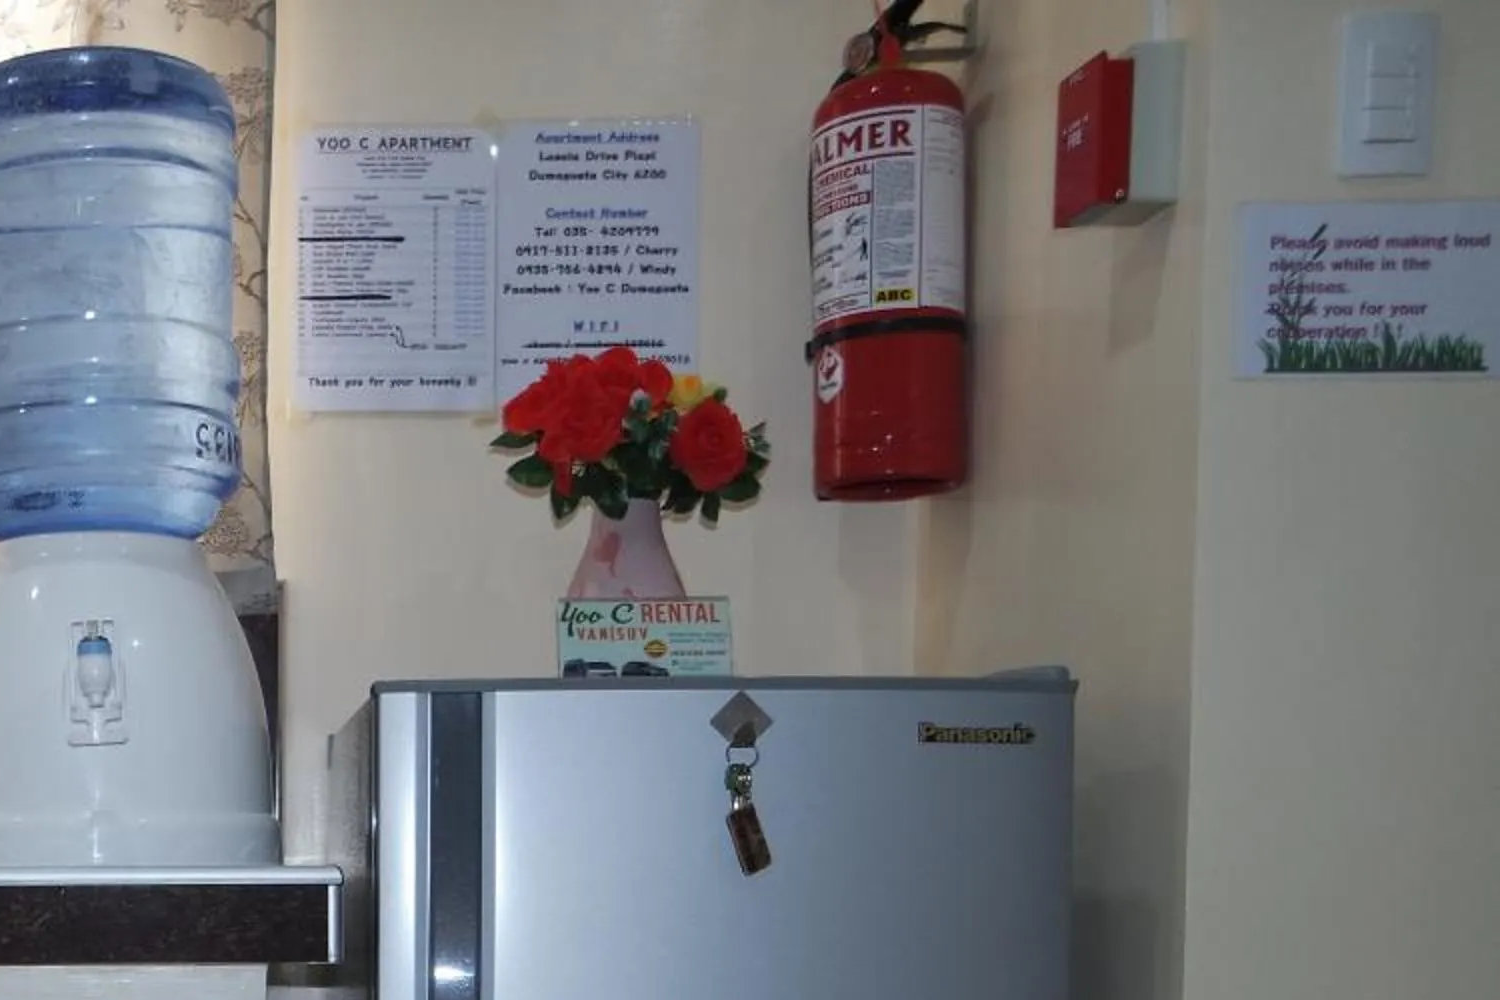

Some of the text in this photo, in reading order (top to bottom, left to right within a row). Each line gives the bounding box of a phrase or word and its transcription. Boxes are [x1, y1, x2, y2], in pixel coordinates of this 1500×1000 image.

[316, 136, 473, 150] YOO C APARTMENT
[602, 169, 629, 182] City
[545, 206, 649, 219] Contact Number
[1269, 233, 1492, 251] Please avoid making loud
[1330, 257, 1375, 272] while
[1380, 257, 1396, 271] in
[1402, 257, 1432, 272] the
[577, 283, 600, 294] Yoo
[605, 283, 615, 294] C
[875, 288, 914, 302] ABC
[1322, 303, 1353, 319] you
[1358, 302, 1385, 317] for
[1389, 302, 1428, 318] your
[344, 378, 363, 388] you
[388, 378, 414, 389] your
[560, 601, 721, 637] Yoo C RENTAL
[917, 721, 1036, 745] Panasonic
